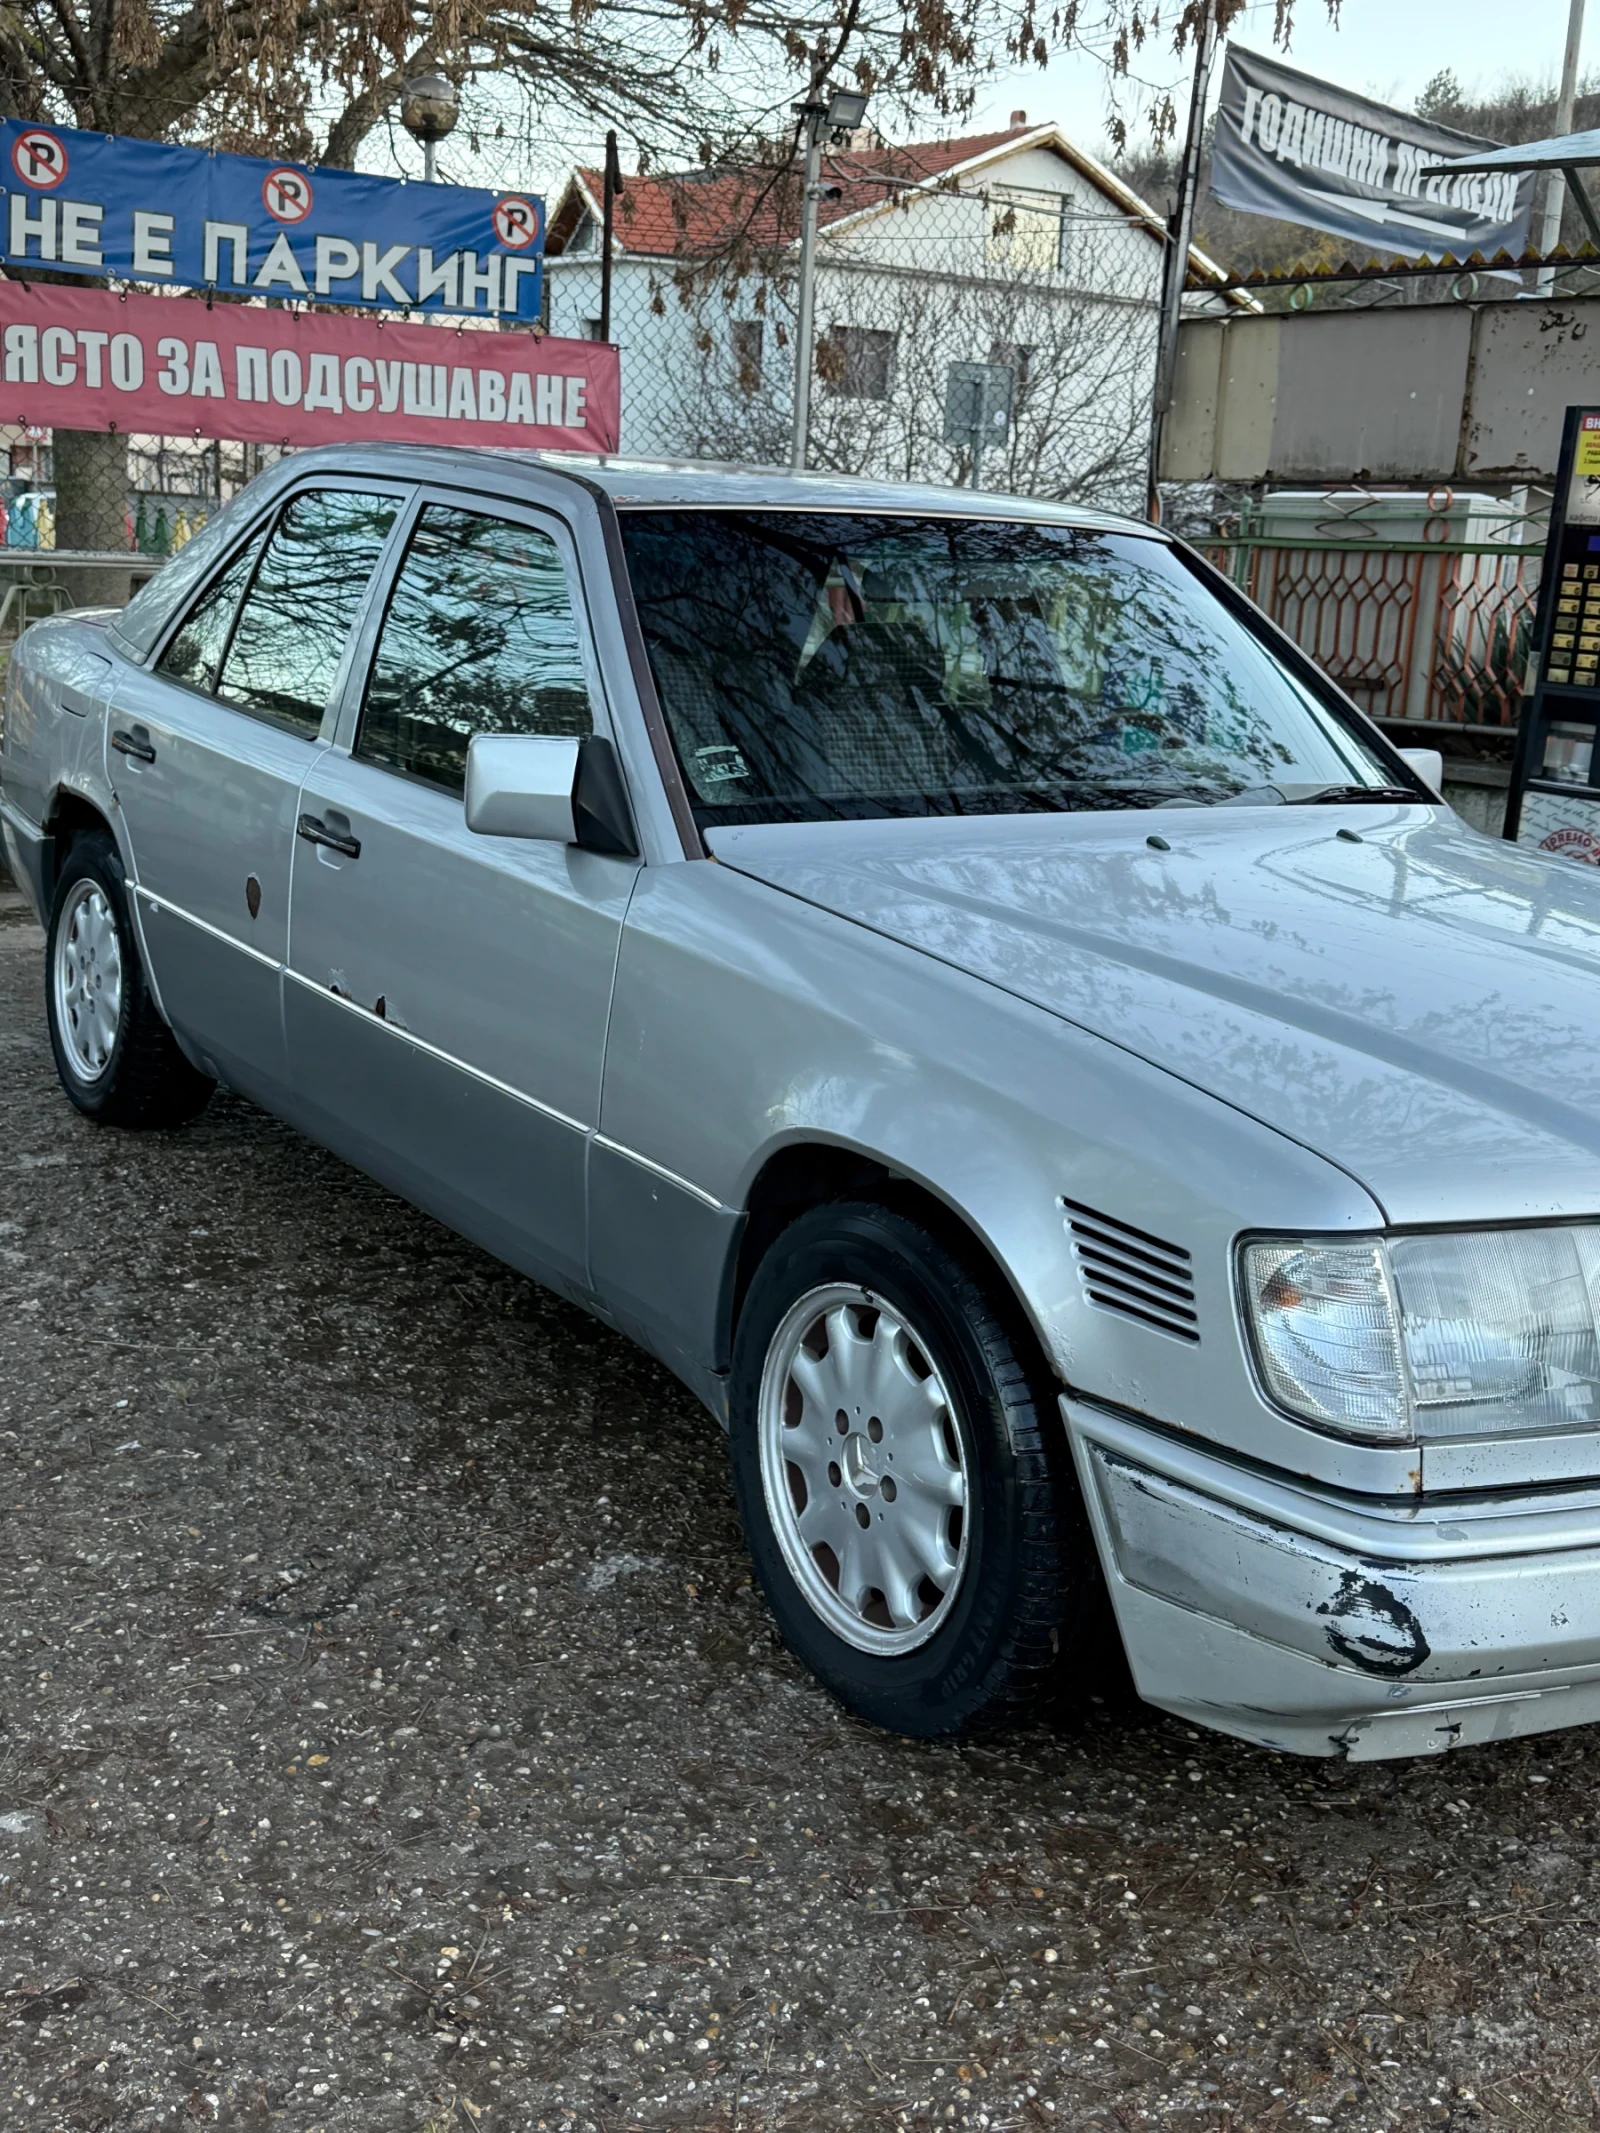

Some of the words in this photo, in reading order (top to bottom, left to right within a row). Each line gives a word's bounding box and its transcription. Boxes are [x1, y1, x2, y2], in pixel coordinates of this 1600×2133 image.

[1241, 86, 1390, 189] ГОДИШНИ
[9, 193, 104, 267] НЕ
[133, 210, 175, 276] Е
[204, 220, 536, 314] ПАРКИНГ
[0, 323, 145, 392] ЯСТО
[157, 337, 225, 399] ЗА
[235, 345, 588, 429] ПОДСУШАВАНЕ
